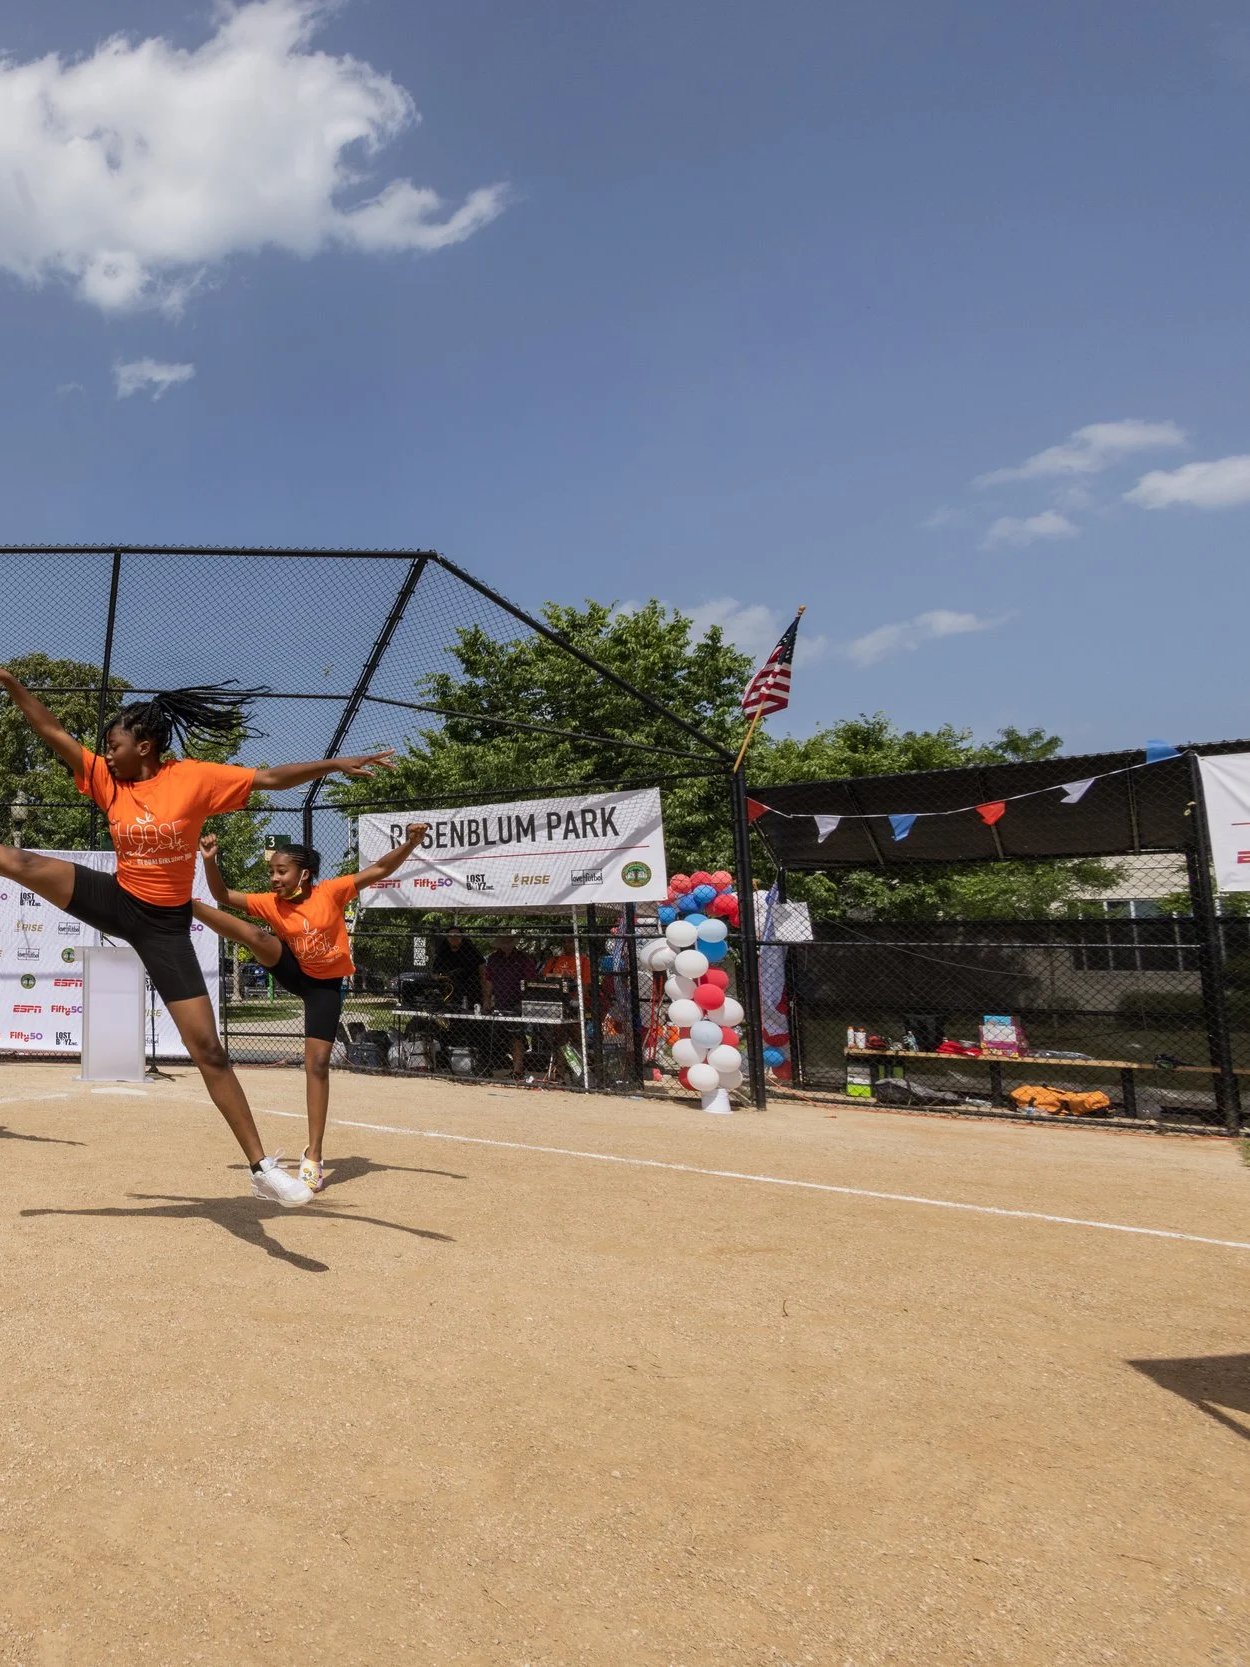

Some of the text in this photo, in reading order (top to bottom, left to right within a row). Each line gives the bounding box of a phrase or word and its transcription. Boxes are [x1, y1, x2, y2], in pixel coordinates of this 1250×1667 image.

[390, 806, 620, 851] RSENBLUM PARK
[268, 835, 276, 848] 3
[466, 873, 486, 883] LOST
[521, 875, 551, 885] RISE
[370, 880, 401, 889] ESPN
[414, 878, 454, 891] Fifty50
[20, 892, 35, 900] LOST
[22, 923, 44, 932] RISE
[54, 979, 83, 987] ESPN
[12, 1004, 42, 1014] ESPN
[10, 1031, 43, 1042] Fifty50
[55, 1031, 71, 1039] LOST
